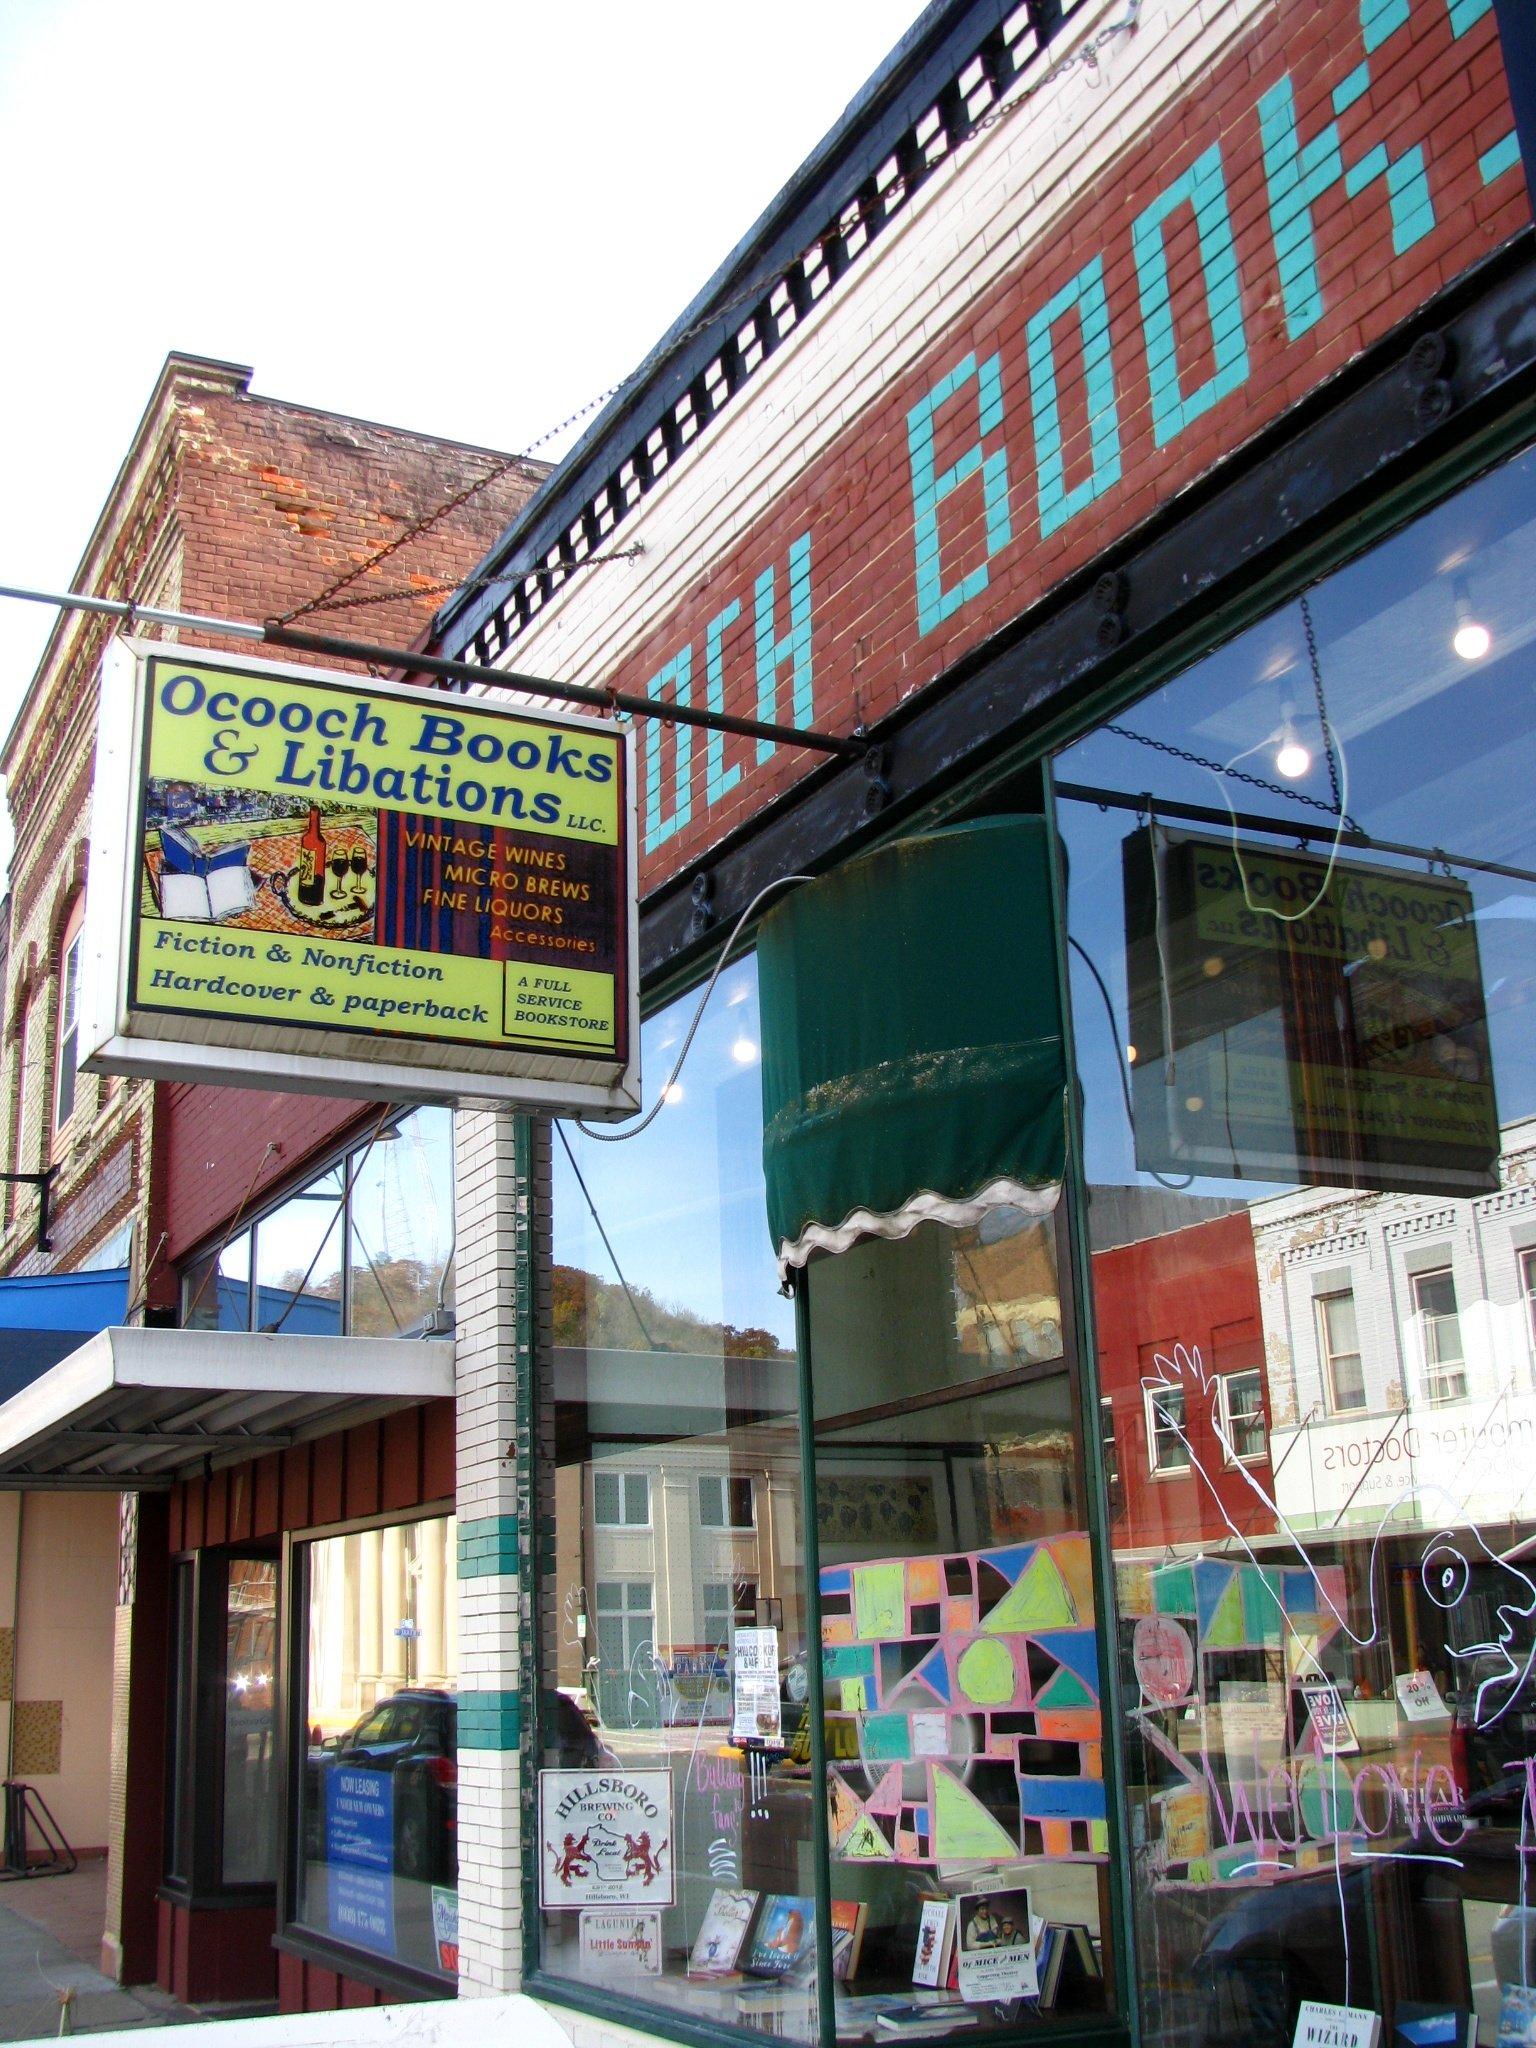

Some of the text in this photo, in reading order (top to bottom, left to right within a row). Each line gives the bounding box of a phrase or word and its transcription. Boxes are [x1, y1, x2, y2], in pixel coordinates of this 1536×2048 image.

[161, 674, 613, 782] Ocooch Books
[204, 729, 607, 834] & Libations LLC.
[405, 831, 566, 871] VINTAGE WINES
[445, 864, 591, 901] MICRO BREWS
[423, 888, 564, 925] FINE LIQUORS
[490, 926, 596, 953] Accessories
[154, 930, 445, 982] Fiction & Nonfiction
[517, 976, 572, 994] A FULL
[149, 969, 489, 1024] Hardcover & paperback
[516, 994, 583, 1011] SERVICE
[515, 1010, 609, 1031] BOOKSTORE
[355, 1778, 380, 1798] LEASING
[555, 1778, 658, 1819] HILLSBORO
[580, 1802, 634, 1812] BREWING
[598, 1812, 615, 1821] CO.
[592, 1838, 617, 1847] Drink
[596, 1849, 621, 1857] Local
[590, 1939, 614, 1950] Little
[963, 1960, 972, 1969] Of
[974, 1957, 999, 1967] MICE
[1008, 1952, 1031, 1963] MEN
[1305, 2004, 1337, 2016] CHARLES
[1348, 2011, 1367, 2021] MANN
[1307, 2027, 1358, 2048] WIZARD
